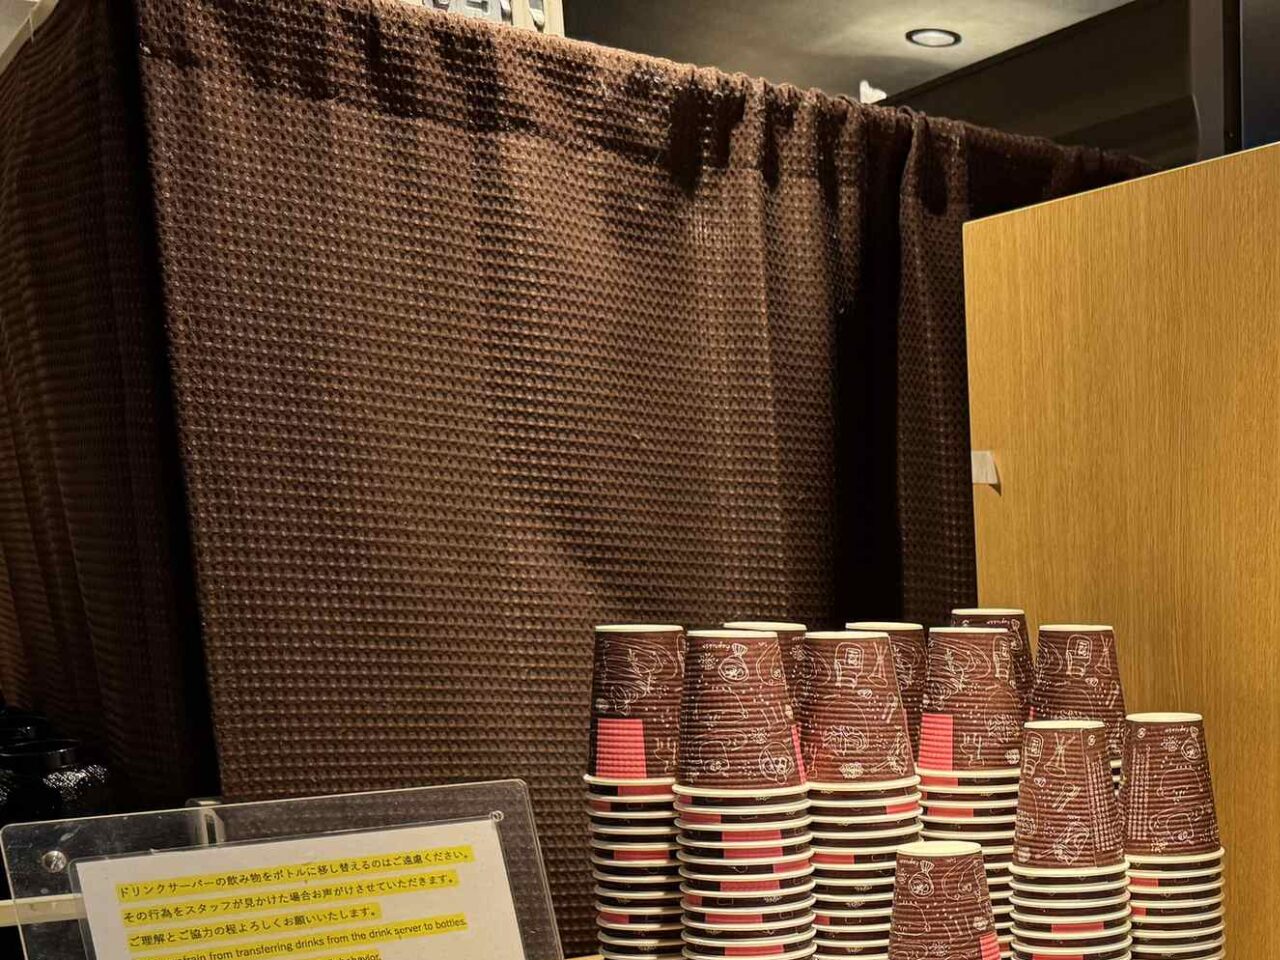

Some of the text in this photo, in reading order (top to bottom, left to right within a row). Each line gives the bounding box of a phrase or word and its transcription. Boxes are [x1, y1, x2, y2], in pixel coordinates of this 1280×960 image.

[235, 942, 293, 958] transferring
[295, 938, 325, 950] drinks
[326, 935, 349, 945] from
[351, 932, 367, 942] the
[368, 928, 392, 939] drink
[394, 925, 422, 936] server
[423, 923, 433, 932] to
[435, 917, 468, 930] bottles.
